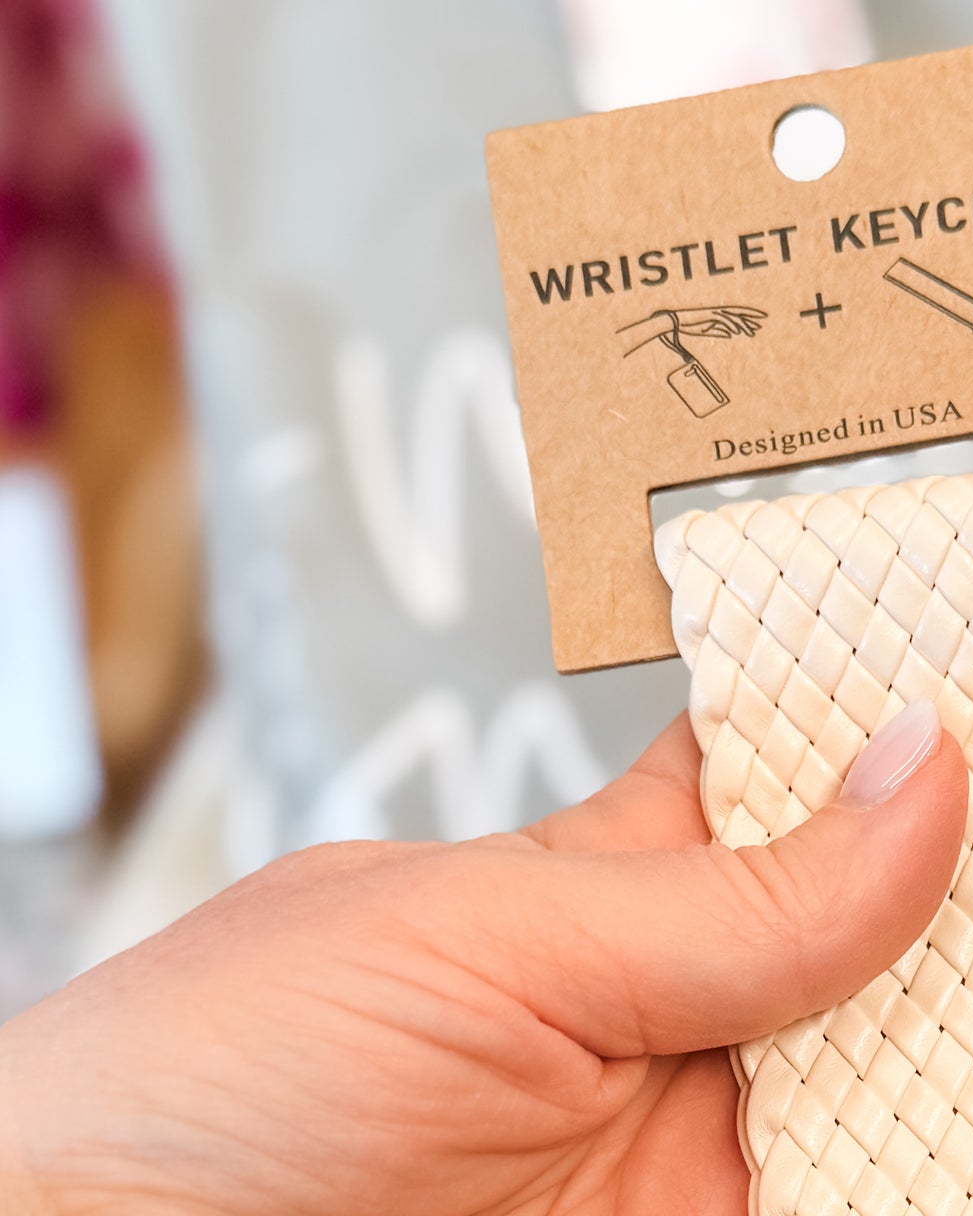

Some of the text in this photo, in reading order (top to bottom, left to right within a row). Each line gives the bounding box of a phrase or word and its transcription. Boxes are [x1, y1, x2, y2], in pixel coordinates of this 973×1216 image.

[530, 225, 797, 305] WRISTLET
[713, 400, 963, 461] Designed in USA
